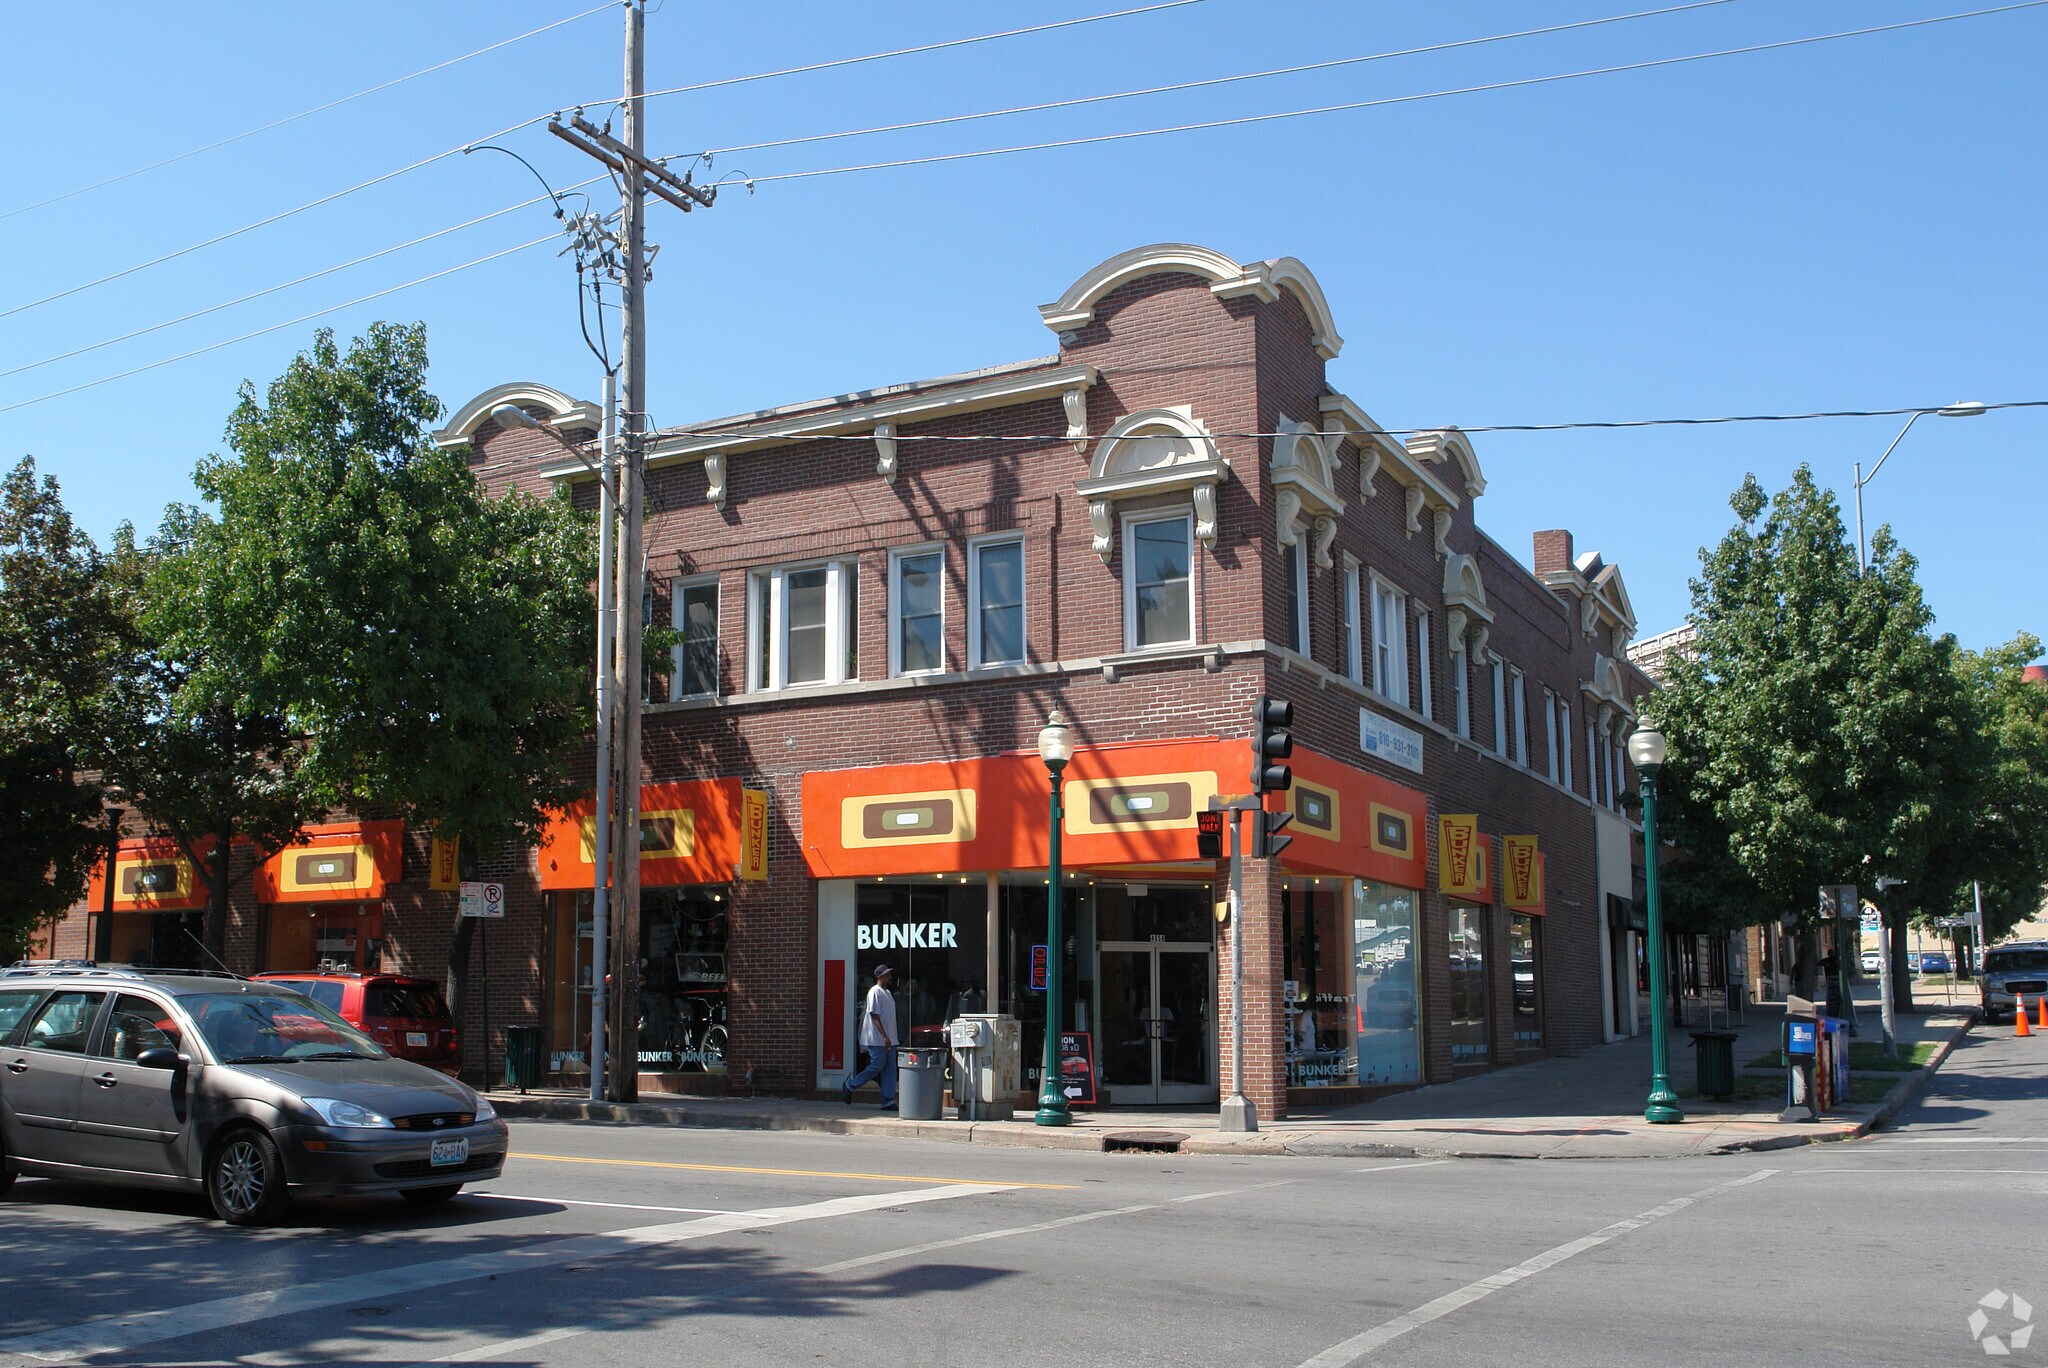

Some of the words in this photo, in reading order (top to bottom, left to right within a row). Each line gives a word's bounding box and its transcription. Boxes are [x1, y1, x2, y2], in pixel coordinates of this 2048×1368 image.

[749, 803, 764, 868] BUNKER
[1449, 827, 1470, 883] BUNKER
[442, 839, 456, 880] NKER
[1512, 847, 1531, 897] BUNKER
[857, 922, 958, 950] BUNKER
[1033, 947, 1047, 987] OPEN
[550, 1051, 585, 1062] BUNKER
[637, 1051, 673, 1063] BUNKER
[681, 1051, 718, 1063] BUNKER
[1299, 1065, 1346, 1076] BUNKER
